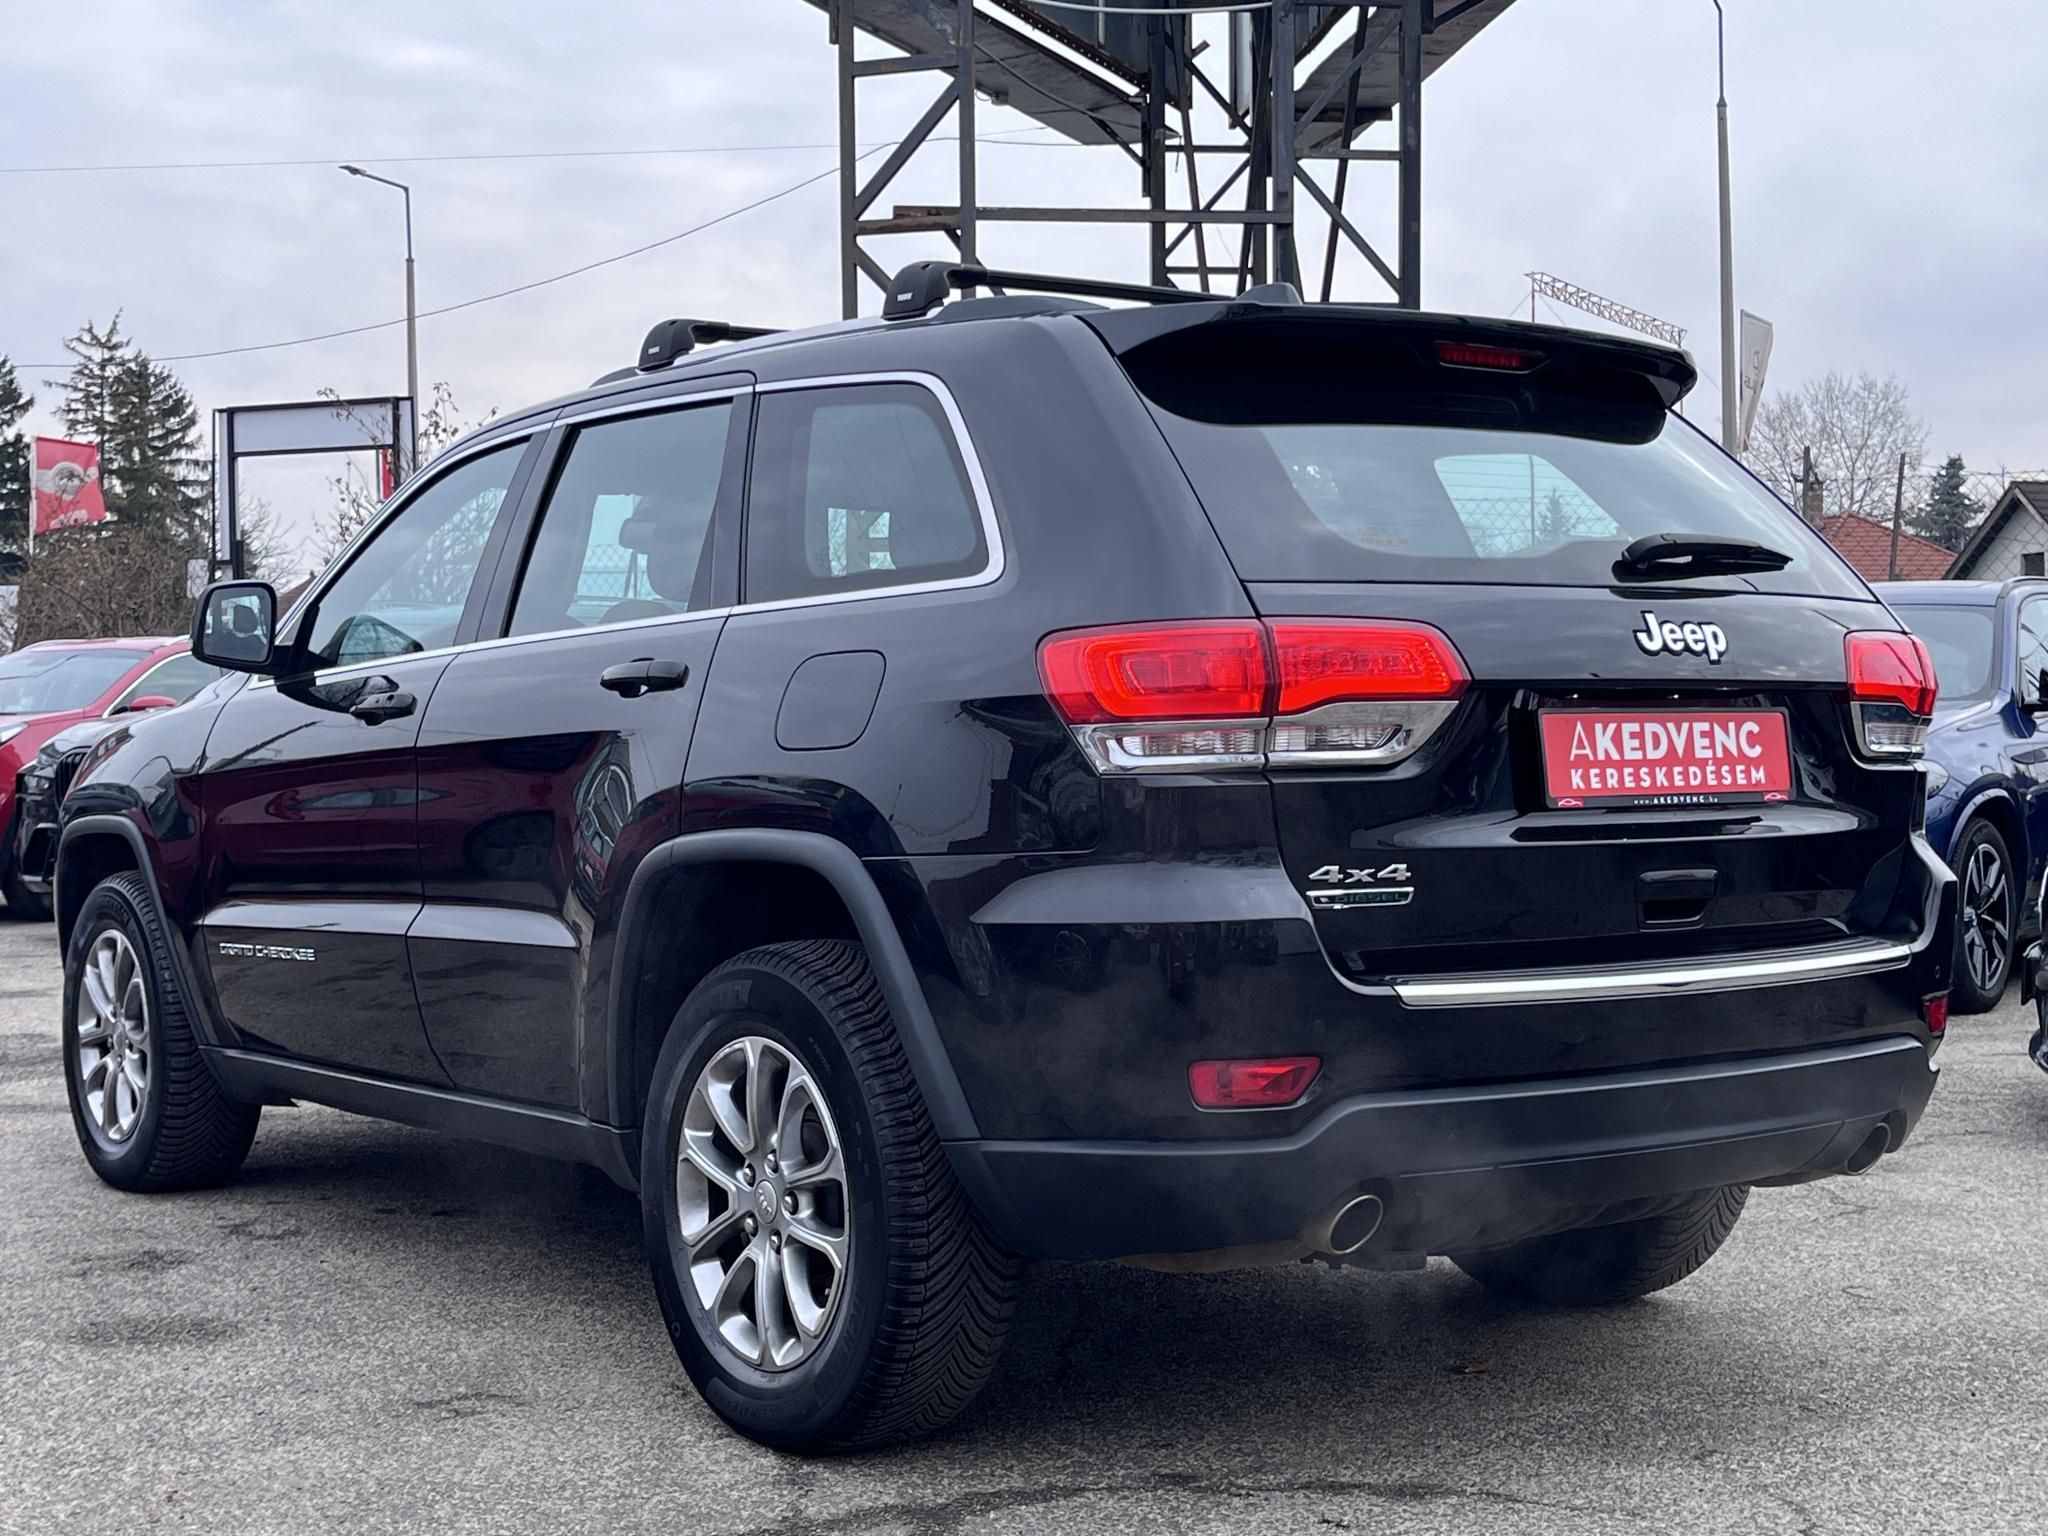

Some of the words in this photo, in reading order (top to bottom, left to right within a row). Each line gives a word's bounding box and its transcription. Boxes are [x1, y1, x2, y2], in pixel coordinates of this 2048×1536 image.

[1632, 610, 1728, 665] Jeep
[1570, 760, 1766, 790] KERESKEDÉSEM
[1308, 864, 1412, 883] 4x4
